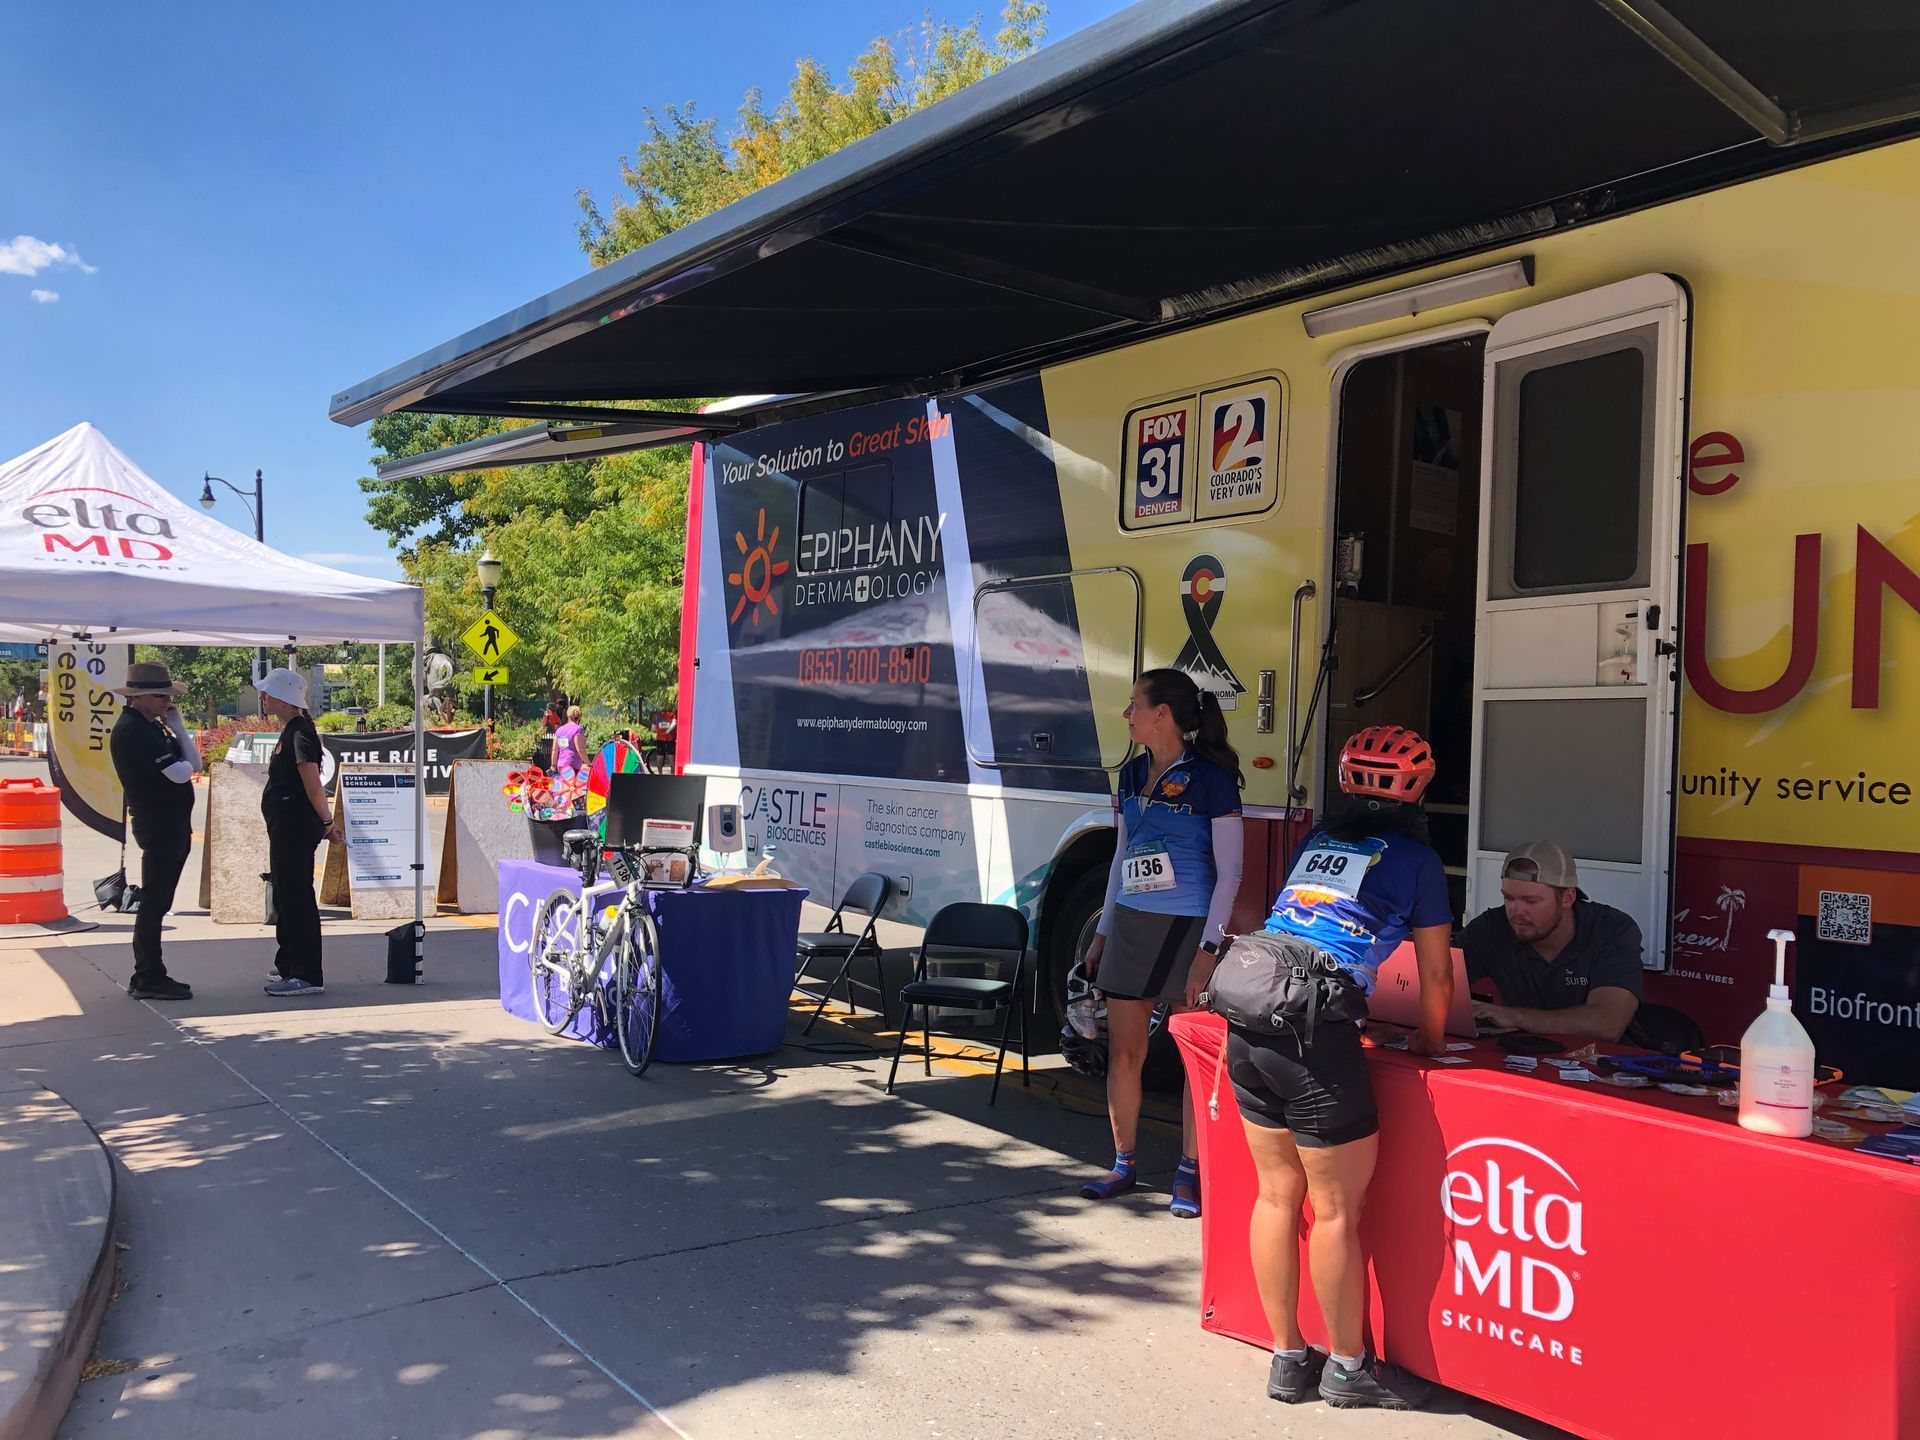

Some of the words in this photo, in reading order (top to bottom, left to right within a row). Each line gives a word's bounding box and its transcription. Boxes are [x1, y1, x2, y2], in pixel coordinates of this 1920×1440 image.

[1143, 412, 1183, 444] FOX
[1217, 400, 1264, 472] 2
[722, 461, 755, 485] Your
[756, 444, 822, 478] Solution
[826, 438, 844, 463] to
[850, 423, 900, 456] Great
[906, 411, 949, 444] Skin
[1140, 443, 1181, 498] 31
[1210, 467, 1262, 487] COLORADO'S
[1210, 485, 1235, 501] VERY
[1238, 481, 1262, 497] OWN
[22, 498, 178, 540] elta
[1138, 500, 1178, 517] DENVER
[43, 533, 173, 561] MD
[800, 512, 948, 573] EPIPHANY
[797, 647, 842, 686] (855)
[846, 645, 931, 685] 300-8510
[88, 689, 114, 751] Skin
[796, 716, 928, 733] www.epiphanydermatology.com
[340, 751, 379, 763] THE
[389, 748, 438, 763] RIE
[1776, 771, 1912, 805] service
[739, 785, 827, 829] CASTLE
[866, 799, 884, 815] The
[886, 800, 904, 816] skin
[906, 806, 939, 820] cancer
[766, 825, 827, 846] BIOSCIENCES
[865, 817, 918, 837] diagnostics
[919, 825, 967, 846] company
[864, 839, 941, 858] castlebiosciences.com
[612, 858, 631, 882] 1136
[1127, 857, 1163, 879] 1136
[1305, 853, 1348, 876] 649
[1674, 931, 1720, 947] rew
[1705, 973, 1736, 985] VIBES
[1440, 1159, 1588, 1256] elta
[1454, 1238, 1575, 1322] MD
[1441, 1309, 1583, 1366] SKINCARE
